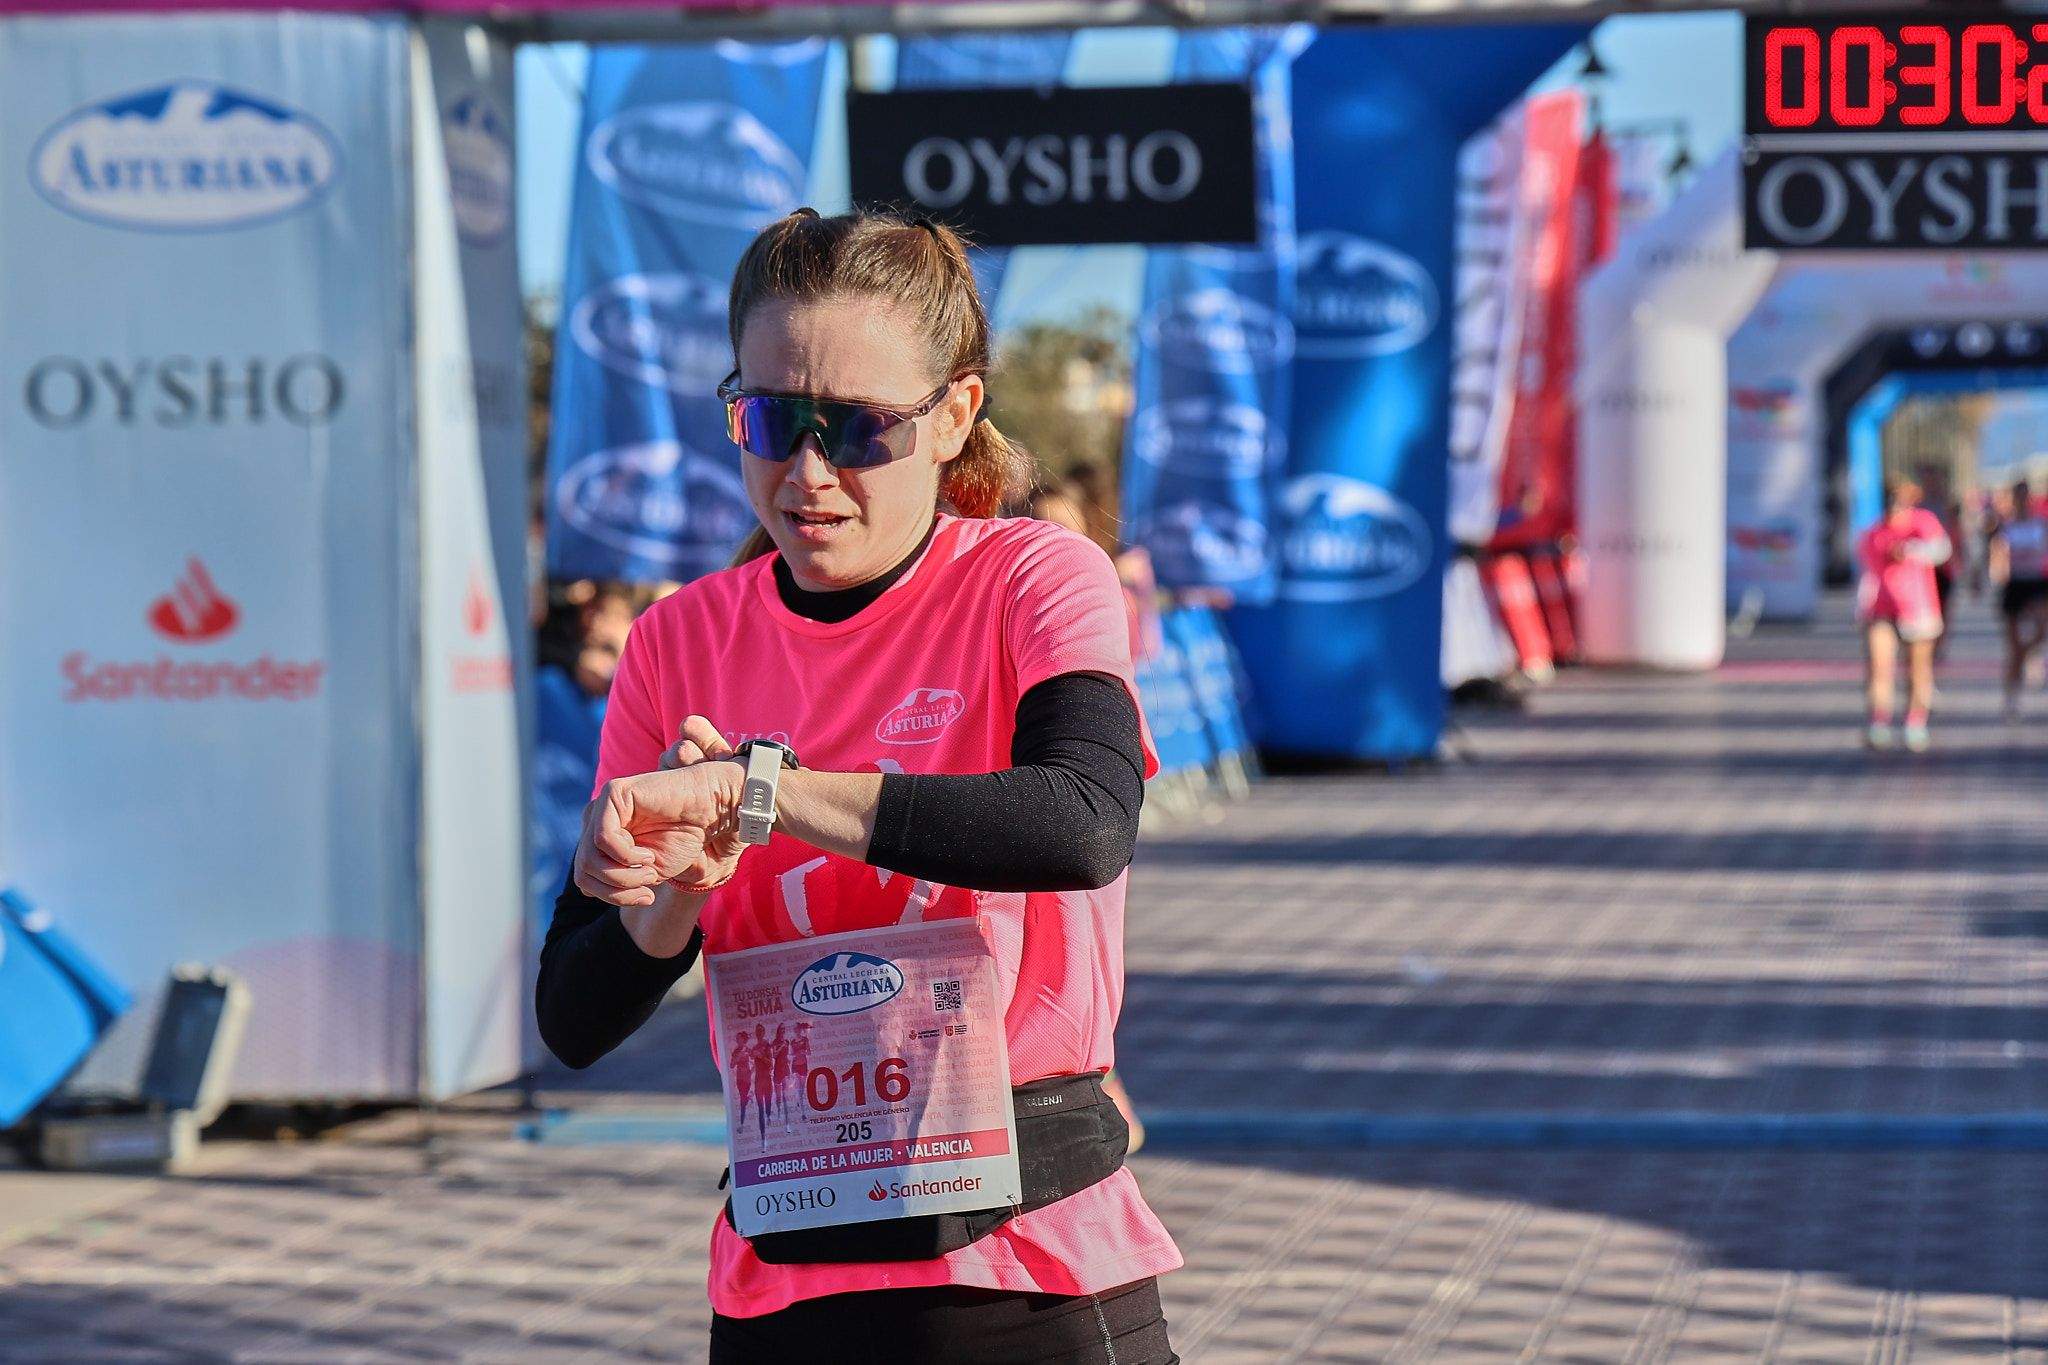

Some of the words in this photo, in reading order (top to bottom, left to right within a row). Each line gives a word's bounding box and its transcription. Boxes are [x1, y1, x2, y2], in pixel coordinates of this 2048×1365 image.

[59, 144, 321, 196] ASTURIANA
[904, 130, 1202, 208] OYSHO
[25, 353, 346, 430] OYSHO
[61, 652, 325, 701] Santander
[798, 976, 896, 1005] ASTURIANA
[812, 973, 847, 984] CENTRAL
[850, 968, 890, 978] LECHERA
[737, 998, 784, 1019] SUMA
[807, 1057, 911, 1111] 016
[835, 1120, 872, 1143] 205
[757, 1160, 808, 1178] CARRERA
[812, 1156, 828, 1171] DE
[831, 1154, 847, 1168] LA
[850, 1149, 894, 1166] MUJER
[906, 1138, 973, 1158] VALENCIA
[755, 1186, 836, 1216] OYSHO
[890, 1176, 982, 1198] Santander
